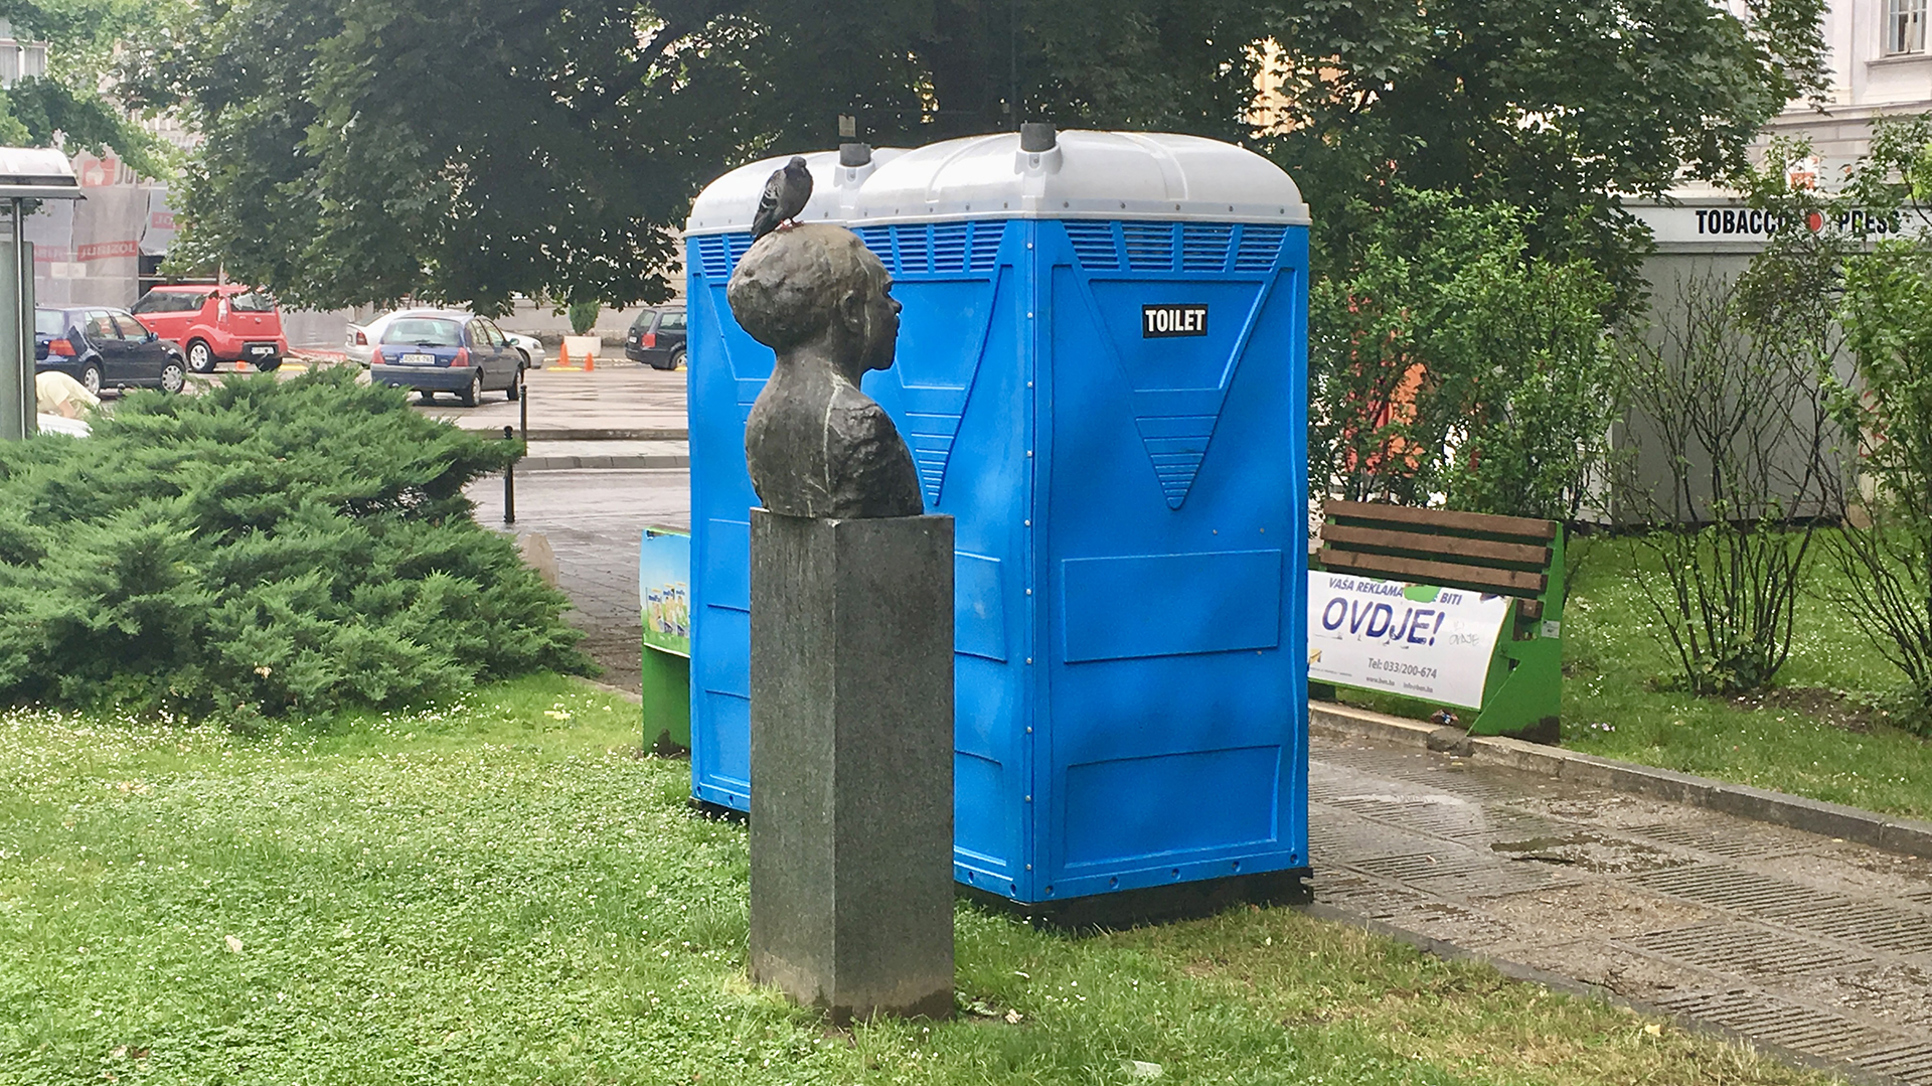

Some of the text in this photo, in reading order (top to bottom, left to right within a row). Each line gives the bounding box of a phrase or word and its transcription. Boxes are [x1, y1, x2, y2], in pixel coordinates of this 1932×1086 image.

[81, 244, 135, 258] JUBIZOL
[1145, 309, 1206, 332] TOILET
[1329, 577, 1463, 605] VAŠA REKLAMA BITI
[1322, 597, 1445, 646] OVDJE!
[1368, 657, 1437, 678] Tel: 033/200-674
